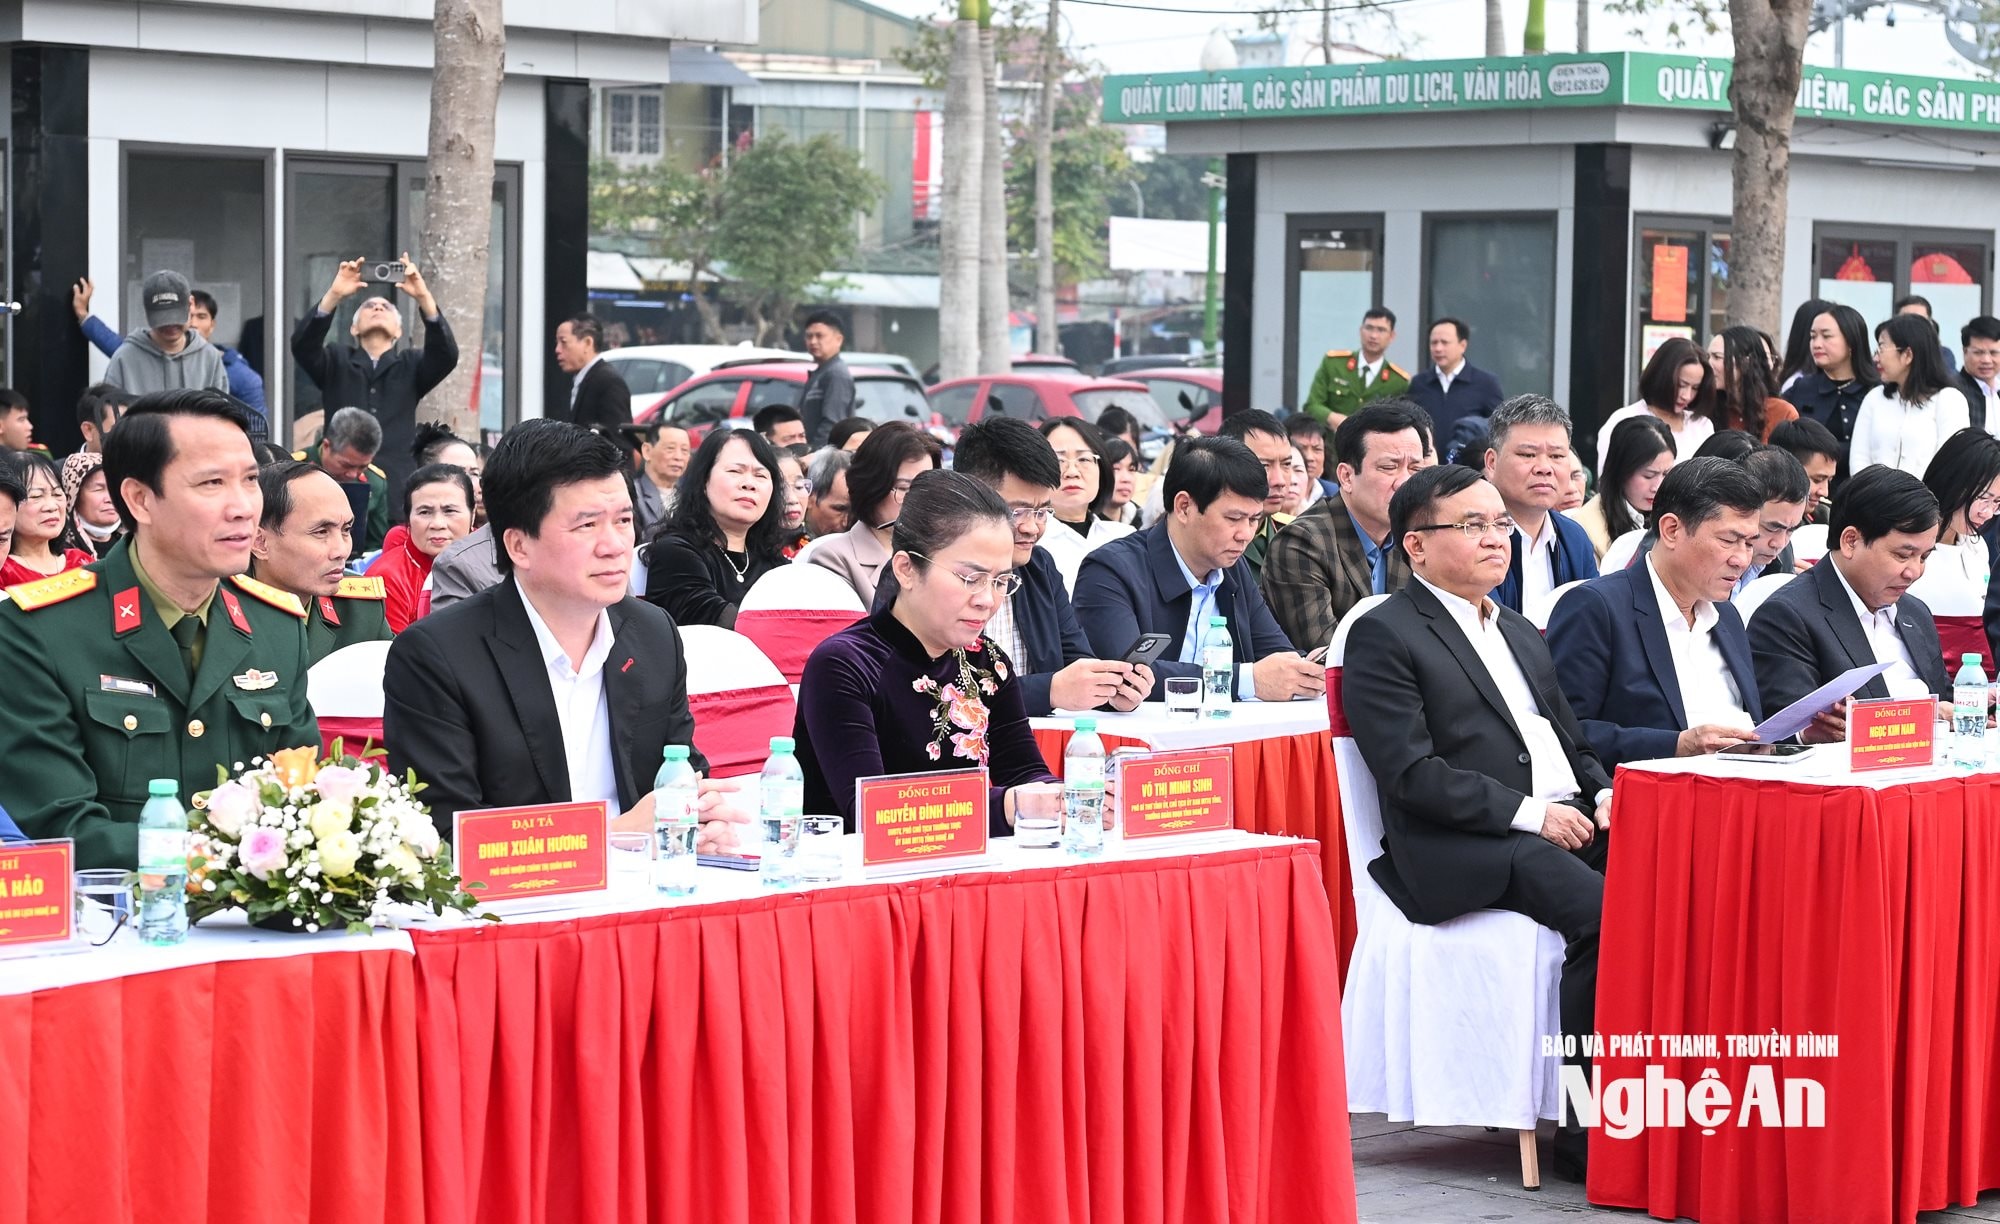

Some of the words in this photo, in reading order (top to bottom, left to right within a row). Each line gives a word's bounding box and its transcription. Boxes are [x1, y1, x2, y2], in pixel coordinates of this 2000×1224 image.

[1166, 82, 1197, 113] LƯU
[1201, 76, 1248, 117] NIỆM,
[1252, 75, 1286, 110] CÁC
[1290, 70, 1326, 109] SẢN
[1330, 65, 1381, 107] PHẨM
[1385, 74, 1409, 104] DU
[1414, 72, 1458, 108] LỊCH,
[1463, 64, 1500, 100] VĂN
[1505, 64, 1542, 100] HÓA
[1657, 59, 1725, 102] QUẦY
[1863, 79, 1910, 116] CÁC
[1917, 81, 1965, 121] SẢN
[1875, 708, 1896, 718] ĐỒNG
[1898, 707, 1911, 716] CHÍ
[1869, 725, 1887, 739] NGỌC
[1888, 724, 1900, 736] KIM
[1901, 723, 1916, 735] NAM
[1154, 764, 1181, 776] ĐỒNG
[1183, 762, 1200, 773] CHÍ
[898, 786, 929, 799] ĐỒNG
[932, 784, 951, 796] CHÍ
[1142, 781, 1152, 797] VÕ
[1154, 782, 1167, 798] THỊ
[1169, 780, 1191, 795] MINH
[1193, 778, 1212, 792] SINH
[511, 818, 534, 831] ĐẠI
[537, 814, 554, 827] TÁ
[876, 803, 916, 825] NGUYỄN
[919, 803, 943, 820] ĐÌNH
[946, 800, 973, 817] HÙNG
[478, 841, 509, 860] ĐINH
[511, 836, 544, 857] XUÂN
[547, 834, 588, 853] HƯƠNG
[0, 857, 19, 871] HÍ
[11, 873, 44, 897] HẢO
